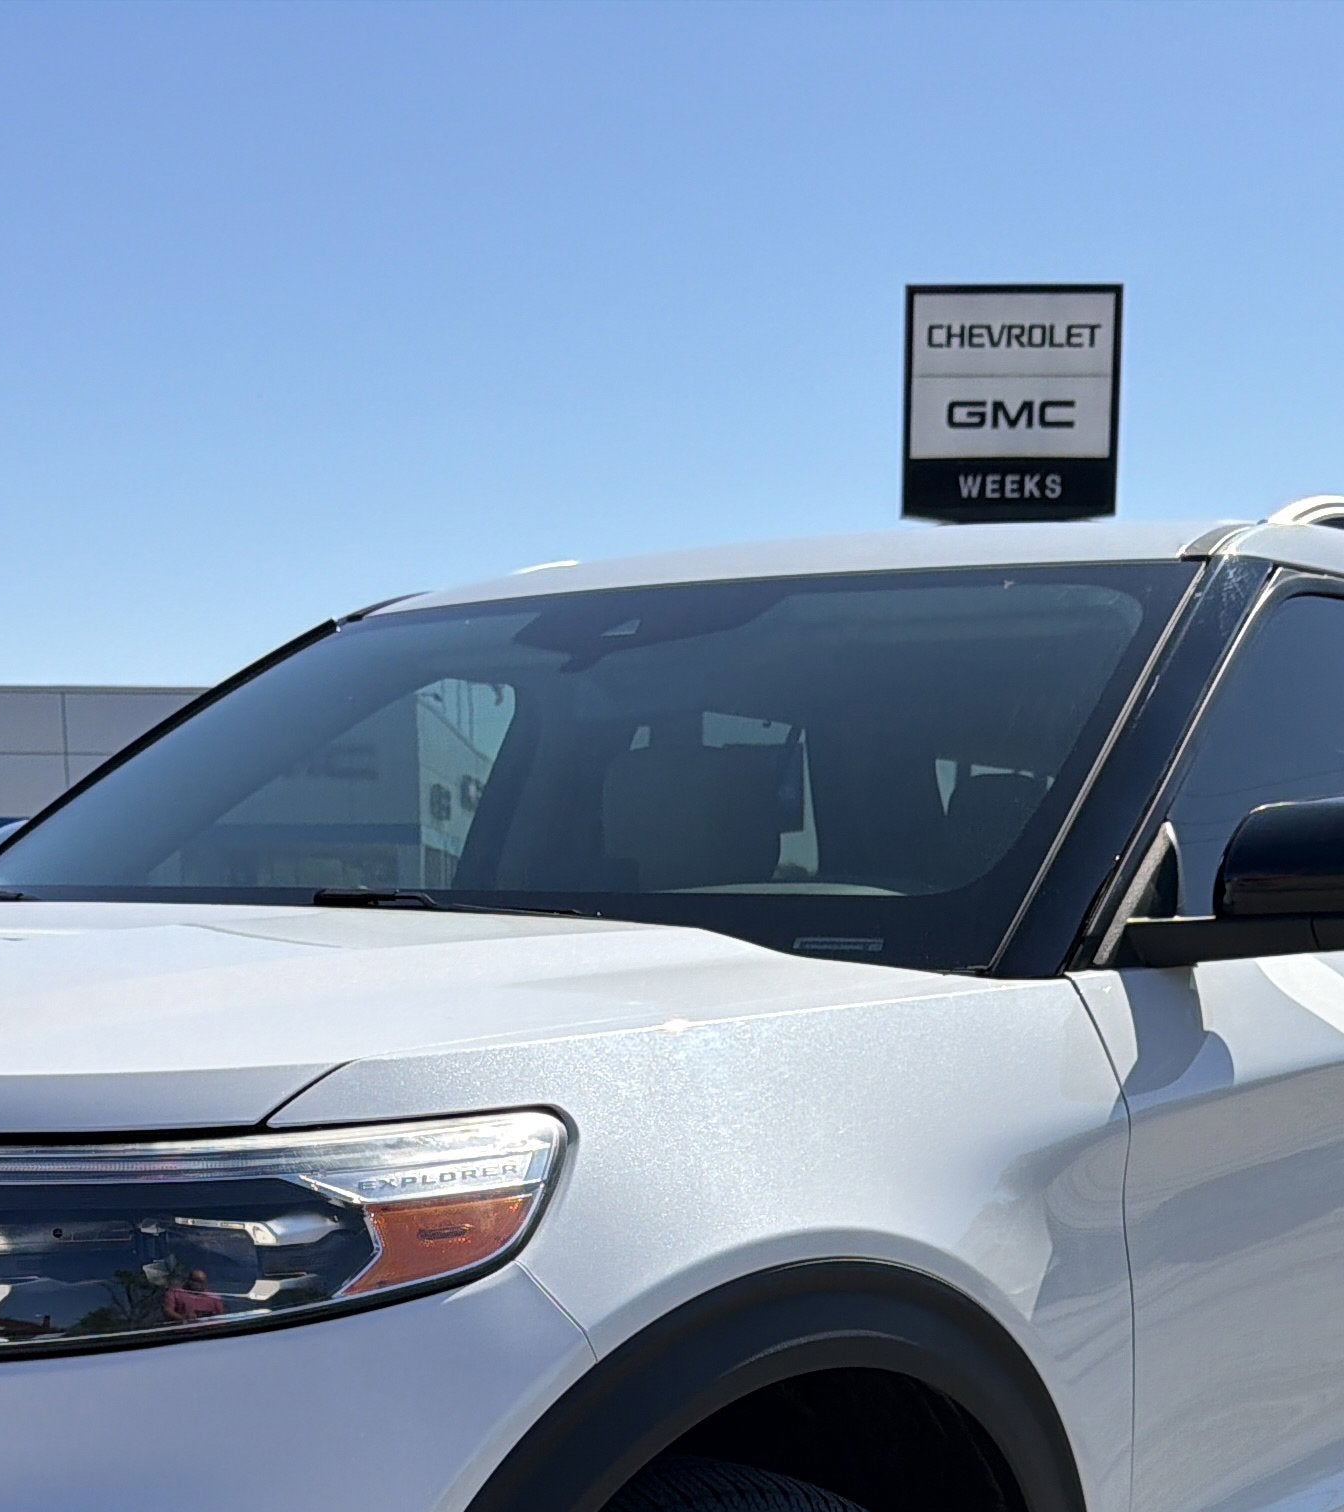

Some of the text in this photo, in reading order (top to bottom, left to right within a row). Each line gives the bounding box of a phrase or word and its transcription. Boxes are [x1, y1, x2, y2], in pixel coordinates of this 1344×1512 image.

[927, 324, 1101, 348] CHEVROLET
[947, 400, 1075, 428] GMC
[958, 474, 1062, 498] WEEKS
[357, 1165, 519, 1191] EXPLORER
